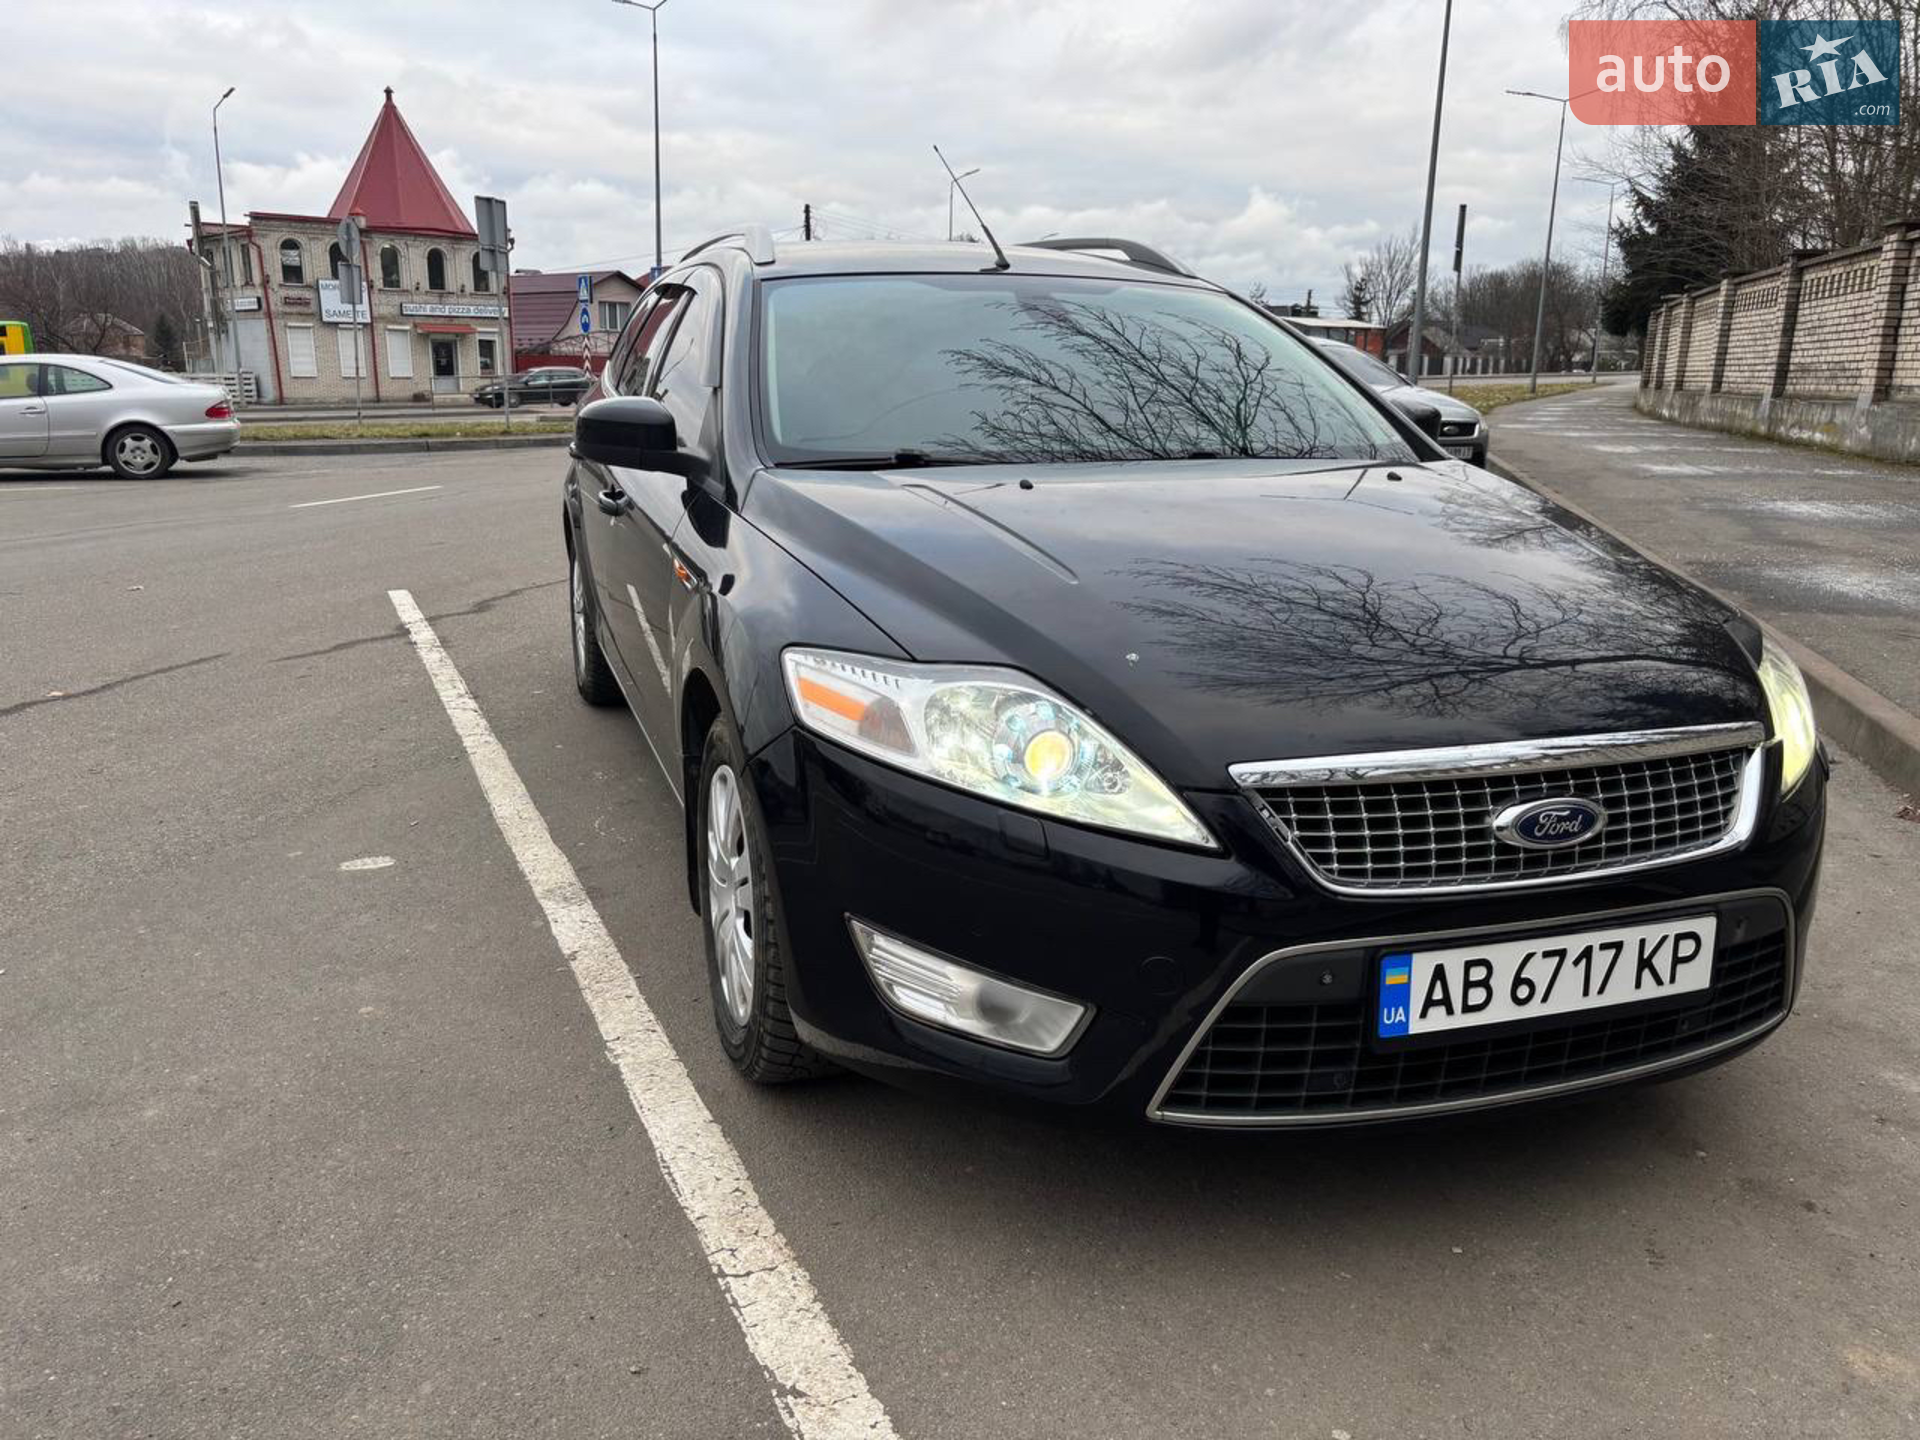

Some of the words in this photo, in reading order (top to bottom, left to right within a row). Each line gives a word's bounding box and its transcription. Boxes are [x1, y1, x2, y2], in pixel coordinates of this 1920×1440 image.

[403, 304, 428, 313] sushi
[429, 305, 446, 313] and
[448, 305, 472, 314] pizza
[1534, 810, 1582, 836] Ford
[1419, 958, 1494, 1019] AB
[1509, 940, 1624, 1006] 6717
[1634, 930, 1702, 990] KP
[1383, 1006, 1407, 1024] UA
